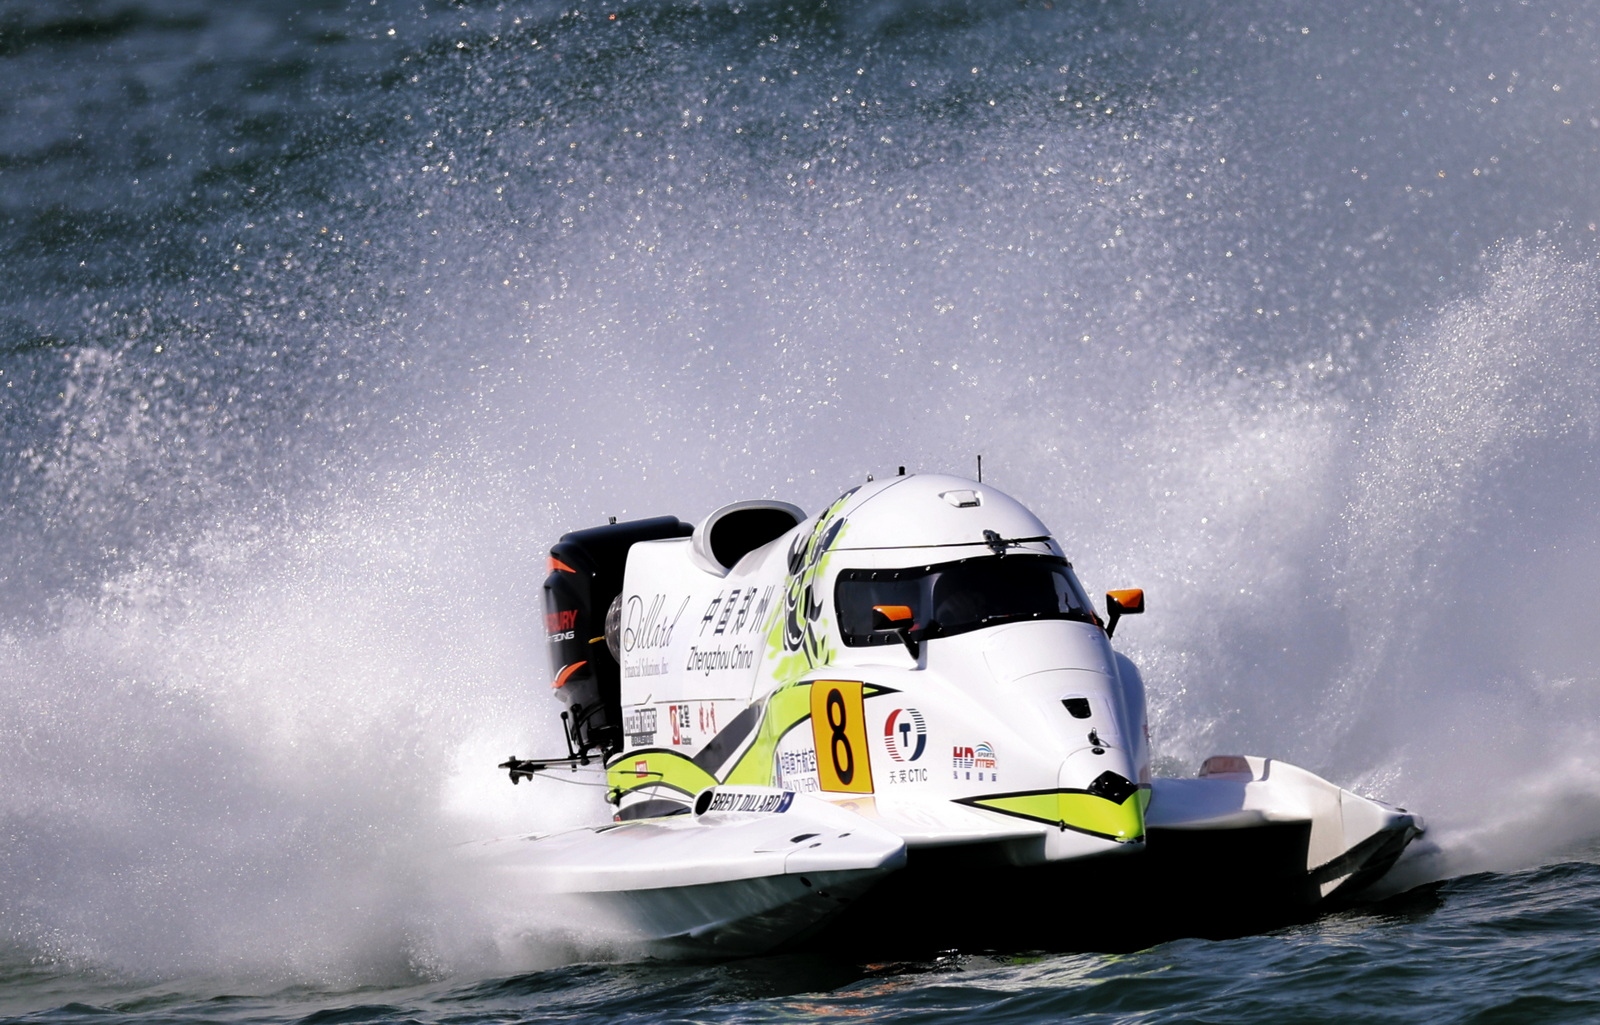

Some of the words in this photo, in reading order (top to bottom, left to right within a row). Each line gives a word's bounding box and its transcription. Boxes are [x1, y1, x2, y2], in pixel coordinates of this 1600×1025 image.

[623, 594, 691, 652] Dillard
[686, 645, 730, 677] Zhengzhou
[730, 644, 754, 670] China
[826, 688, 855, 786] 8
[908, 768, 928, 783] CTIC
[709, 793, 744, 812] BRENT
[737, 794, 782, 813] DILLARD
